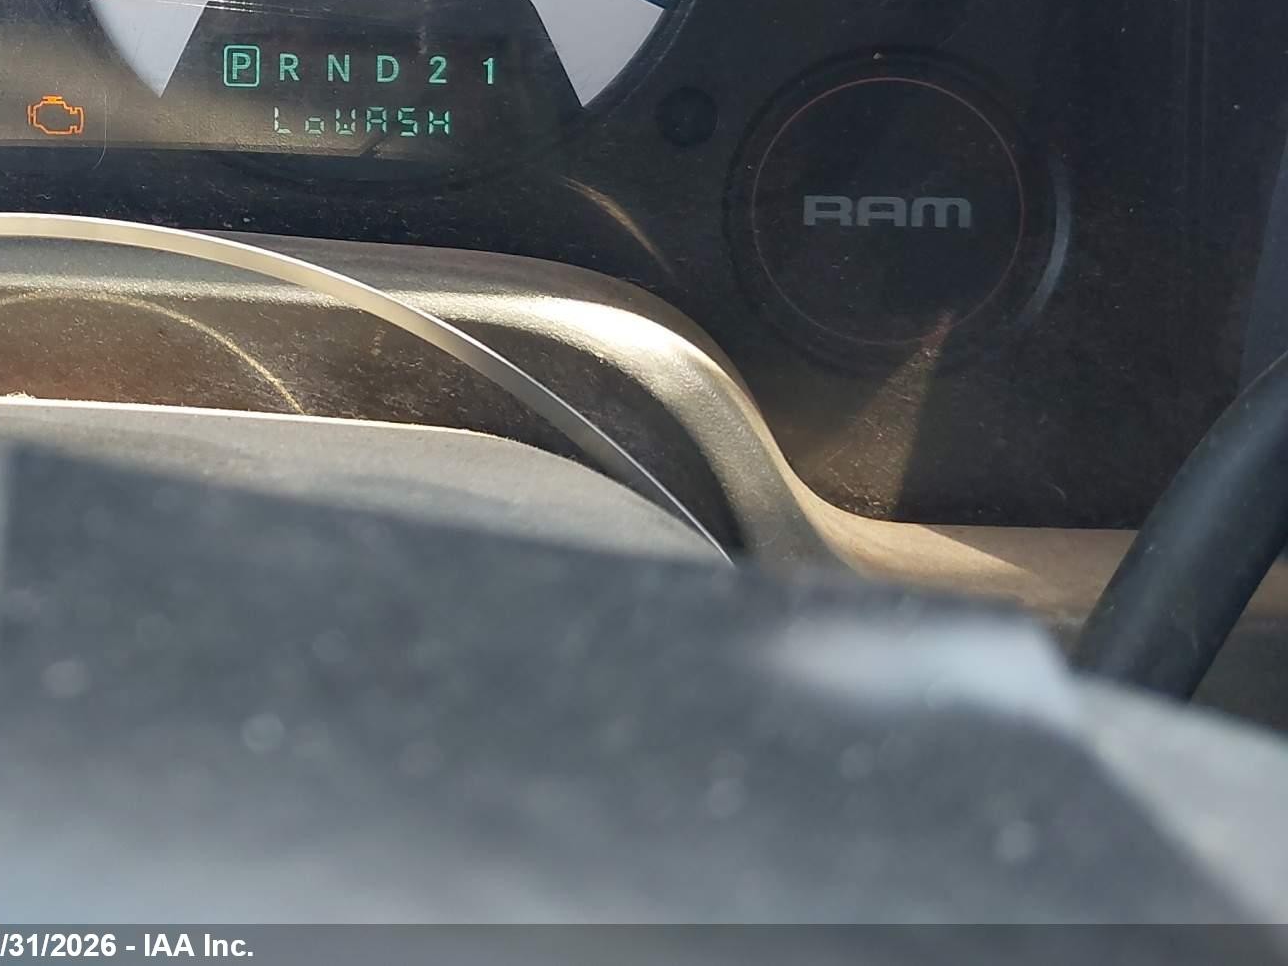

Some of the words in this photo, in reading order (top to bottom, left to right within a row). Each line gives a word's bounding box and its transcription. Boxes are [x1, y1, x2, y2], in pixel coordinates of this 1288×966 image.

[232, 53, 251, 80] P
[280, 54, 300, 81] R
[328, 54, 350, 82] N
[376, 56, 400, 82] D
[429, 56, 447, 83] 2
[483, 58, 494, 84] 1
[803, 194, 972, 228] RAM
